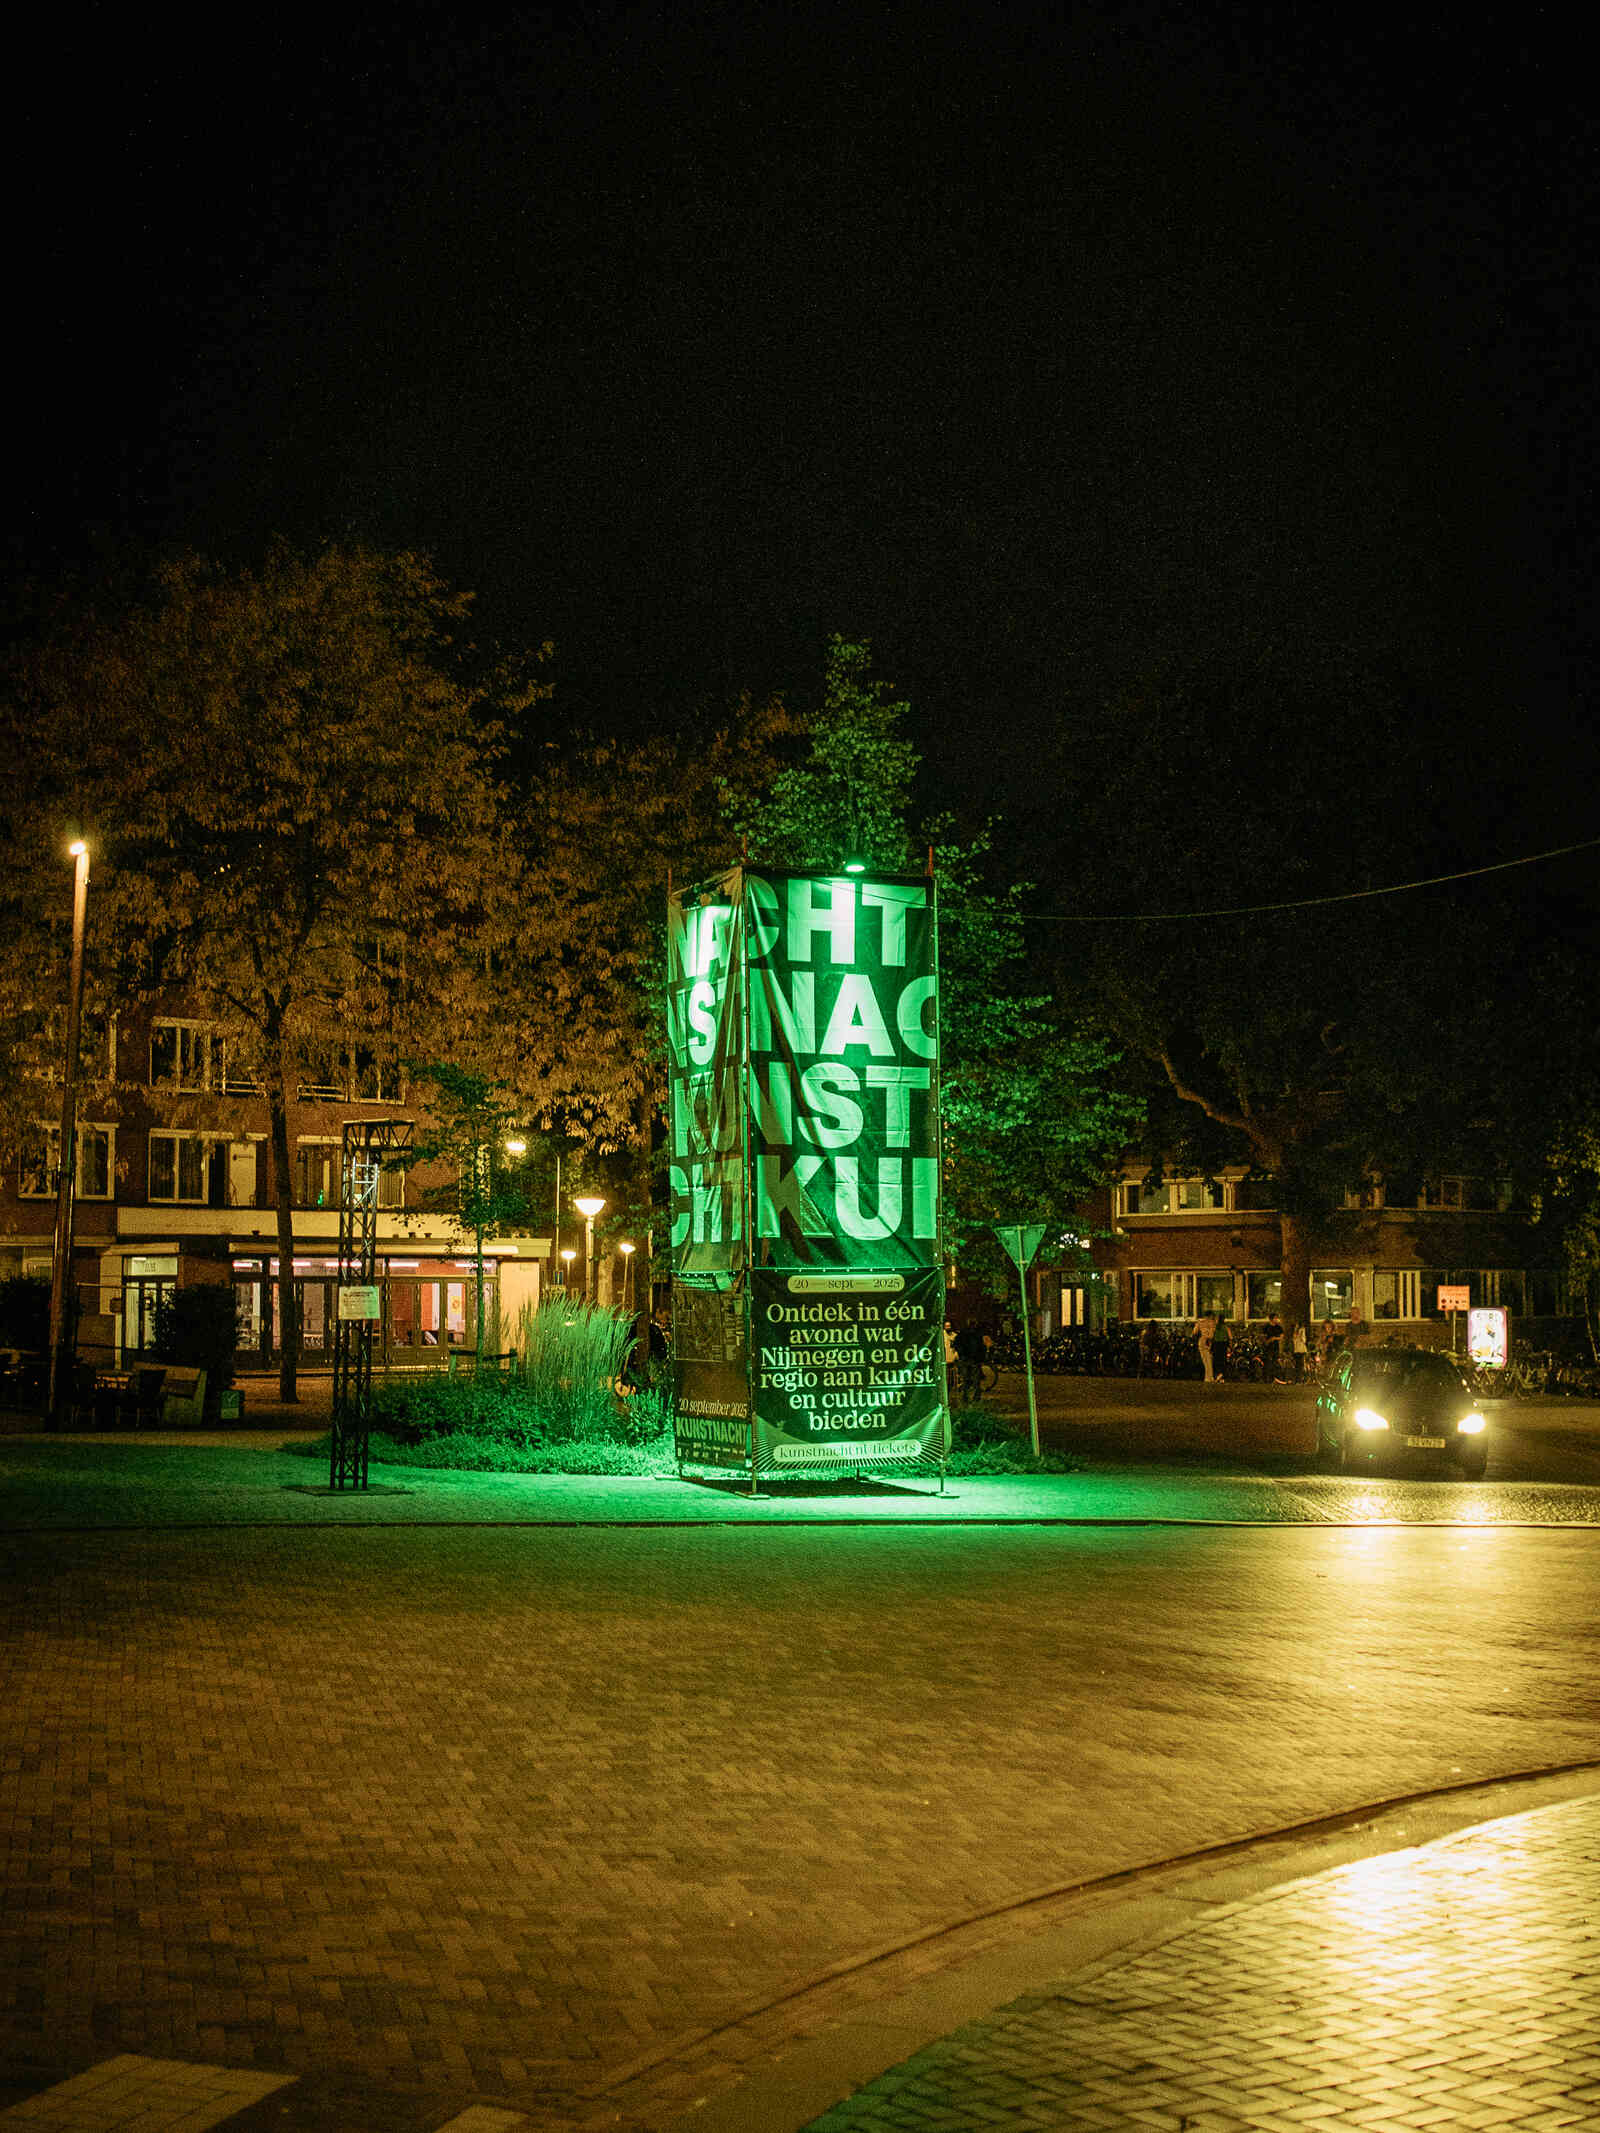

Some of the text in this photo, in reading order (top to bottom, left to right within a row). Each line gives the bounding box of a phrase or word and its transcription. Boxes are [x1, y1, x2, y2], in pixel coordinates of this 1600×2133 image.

[794, 1278, 900, 1290] 20 sept 2025
[767, 1301, 925, 1323] Ontdek in één
[790, 1324, 904, 1344] avond wat
[761, 1344, 932, 1369] Nijmegen en de
[760, 1365, 934, 1392] regio aan kunst
[679, 1398, 689, 1411] 20
[689, 1400, 730, 1416] september
[789, 1388, 906, 1409] en cultuur
[808, 1410, 887, 1431] bieden
